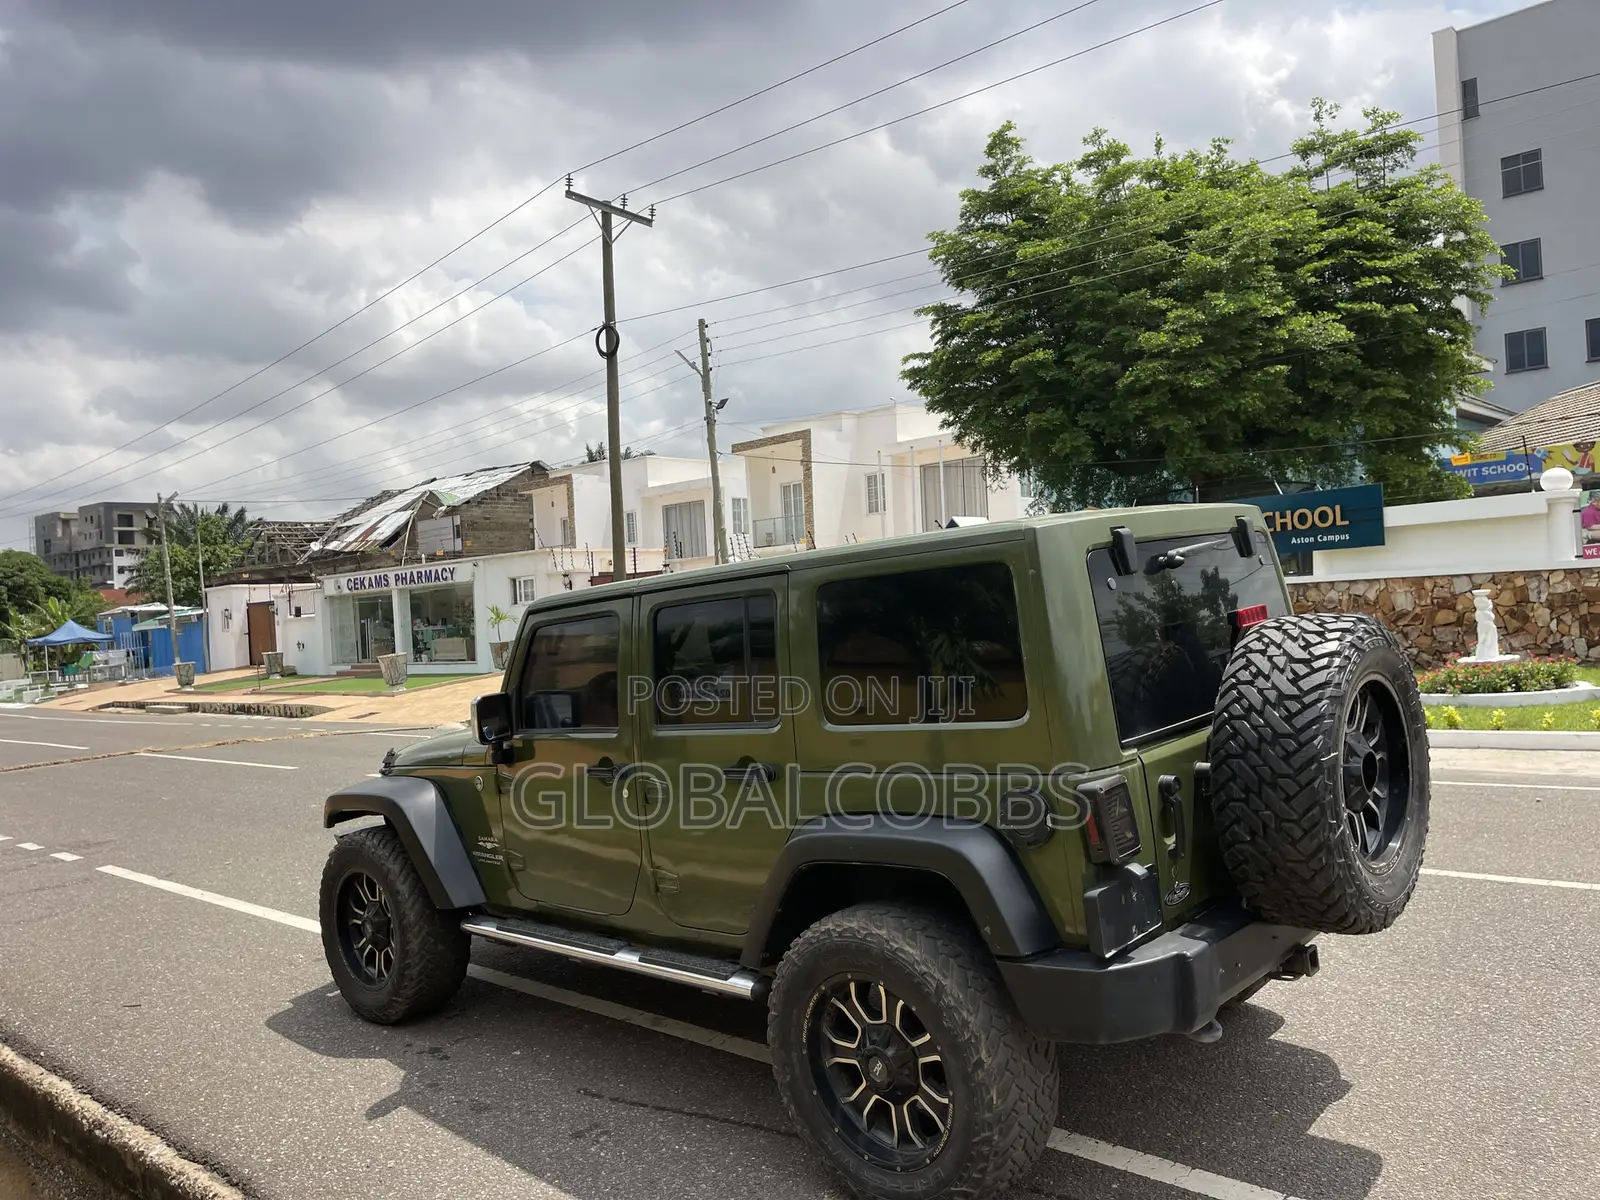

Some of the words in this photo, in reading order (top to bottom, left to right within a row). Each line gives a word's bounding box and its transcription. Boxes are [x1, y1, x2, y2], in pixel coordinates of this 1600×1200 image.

[1291, 536, 1315, 545] Aston
[1317, 533, 1350, 543] Campus
[1584, 547, 1598, 556] WE
[346, 573, 390, 592] CEKAMS
[394, 566, 456, 587] PHARMACY
